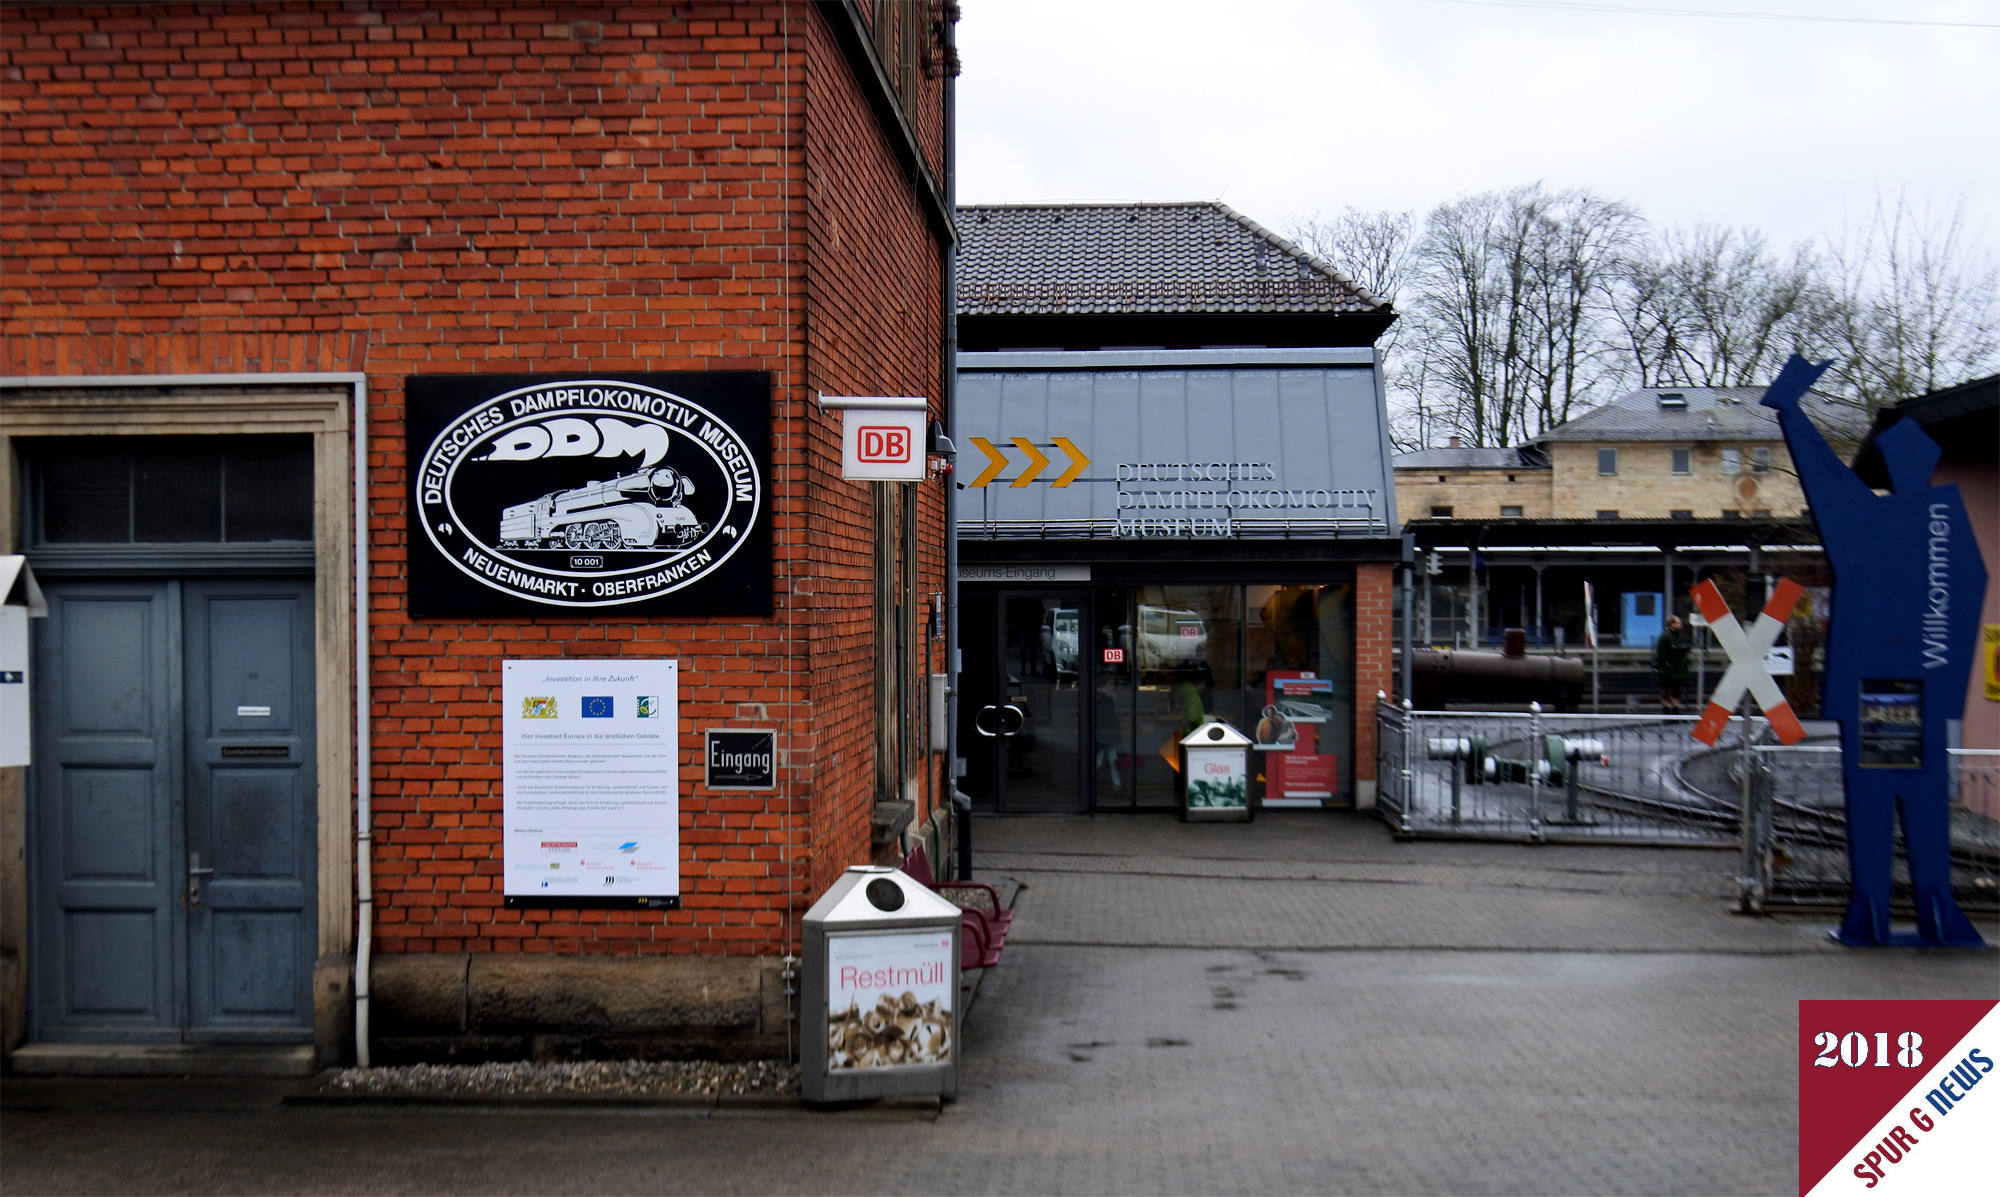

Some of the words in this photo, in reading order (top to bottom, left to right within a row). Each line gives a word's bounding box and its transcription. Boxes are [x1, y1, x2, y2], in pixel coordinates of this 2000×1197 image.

[424, 407, 505, 505] DEUTSCHES
[510, 388, 698, 427] DAMPFLOKOMOTIV
[698, 419, 753, 502] MUSEUM
[471, 418, 670, 468] DDM
[865, 432, 904, 457] DB
[1116, 462, 1276, 482] DEUTSCHES
[1116, 489, 1379, 509] DAMPFLOKOMOTIV
[1116, 517, 1233, 537] MUSEUM
[574, 558, 583, 566] 10
[584, 558, 599, 566] 001
[463, 547, 579, 598] NEUENMARKT
[592, 550, 712, 598] OBERFRANKEN
[958, 566, 1056, 580] useums-Eingang
[1922, 503, 1950, 670] Willkommen
[593, 675, 606, 683] Ihre
[564, 733, 585, 741] Europa
[711, 740, 770, 774] Eingang
[1204, 762, 1231, 775] Glas
[840, 961, 944, 990] Restmüll
